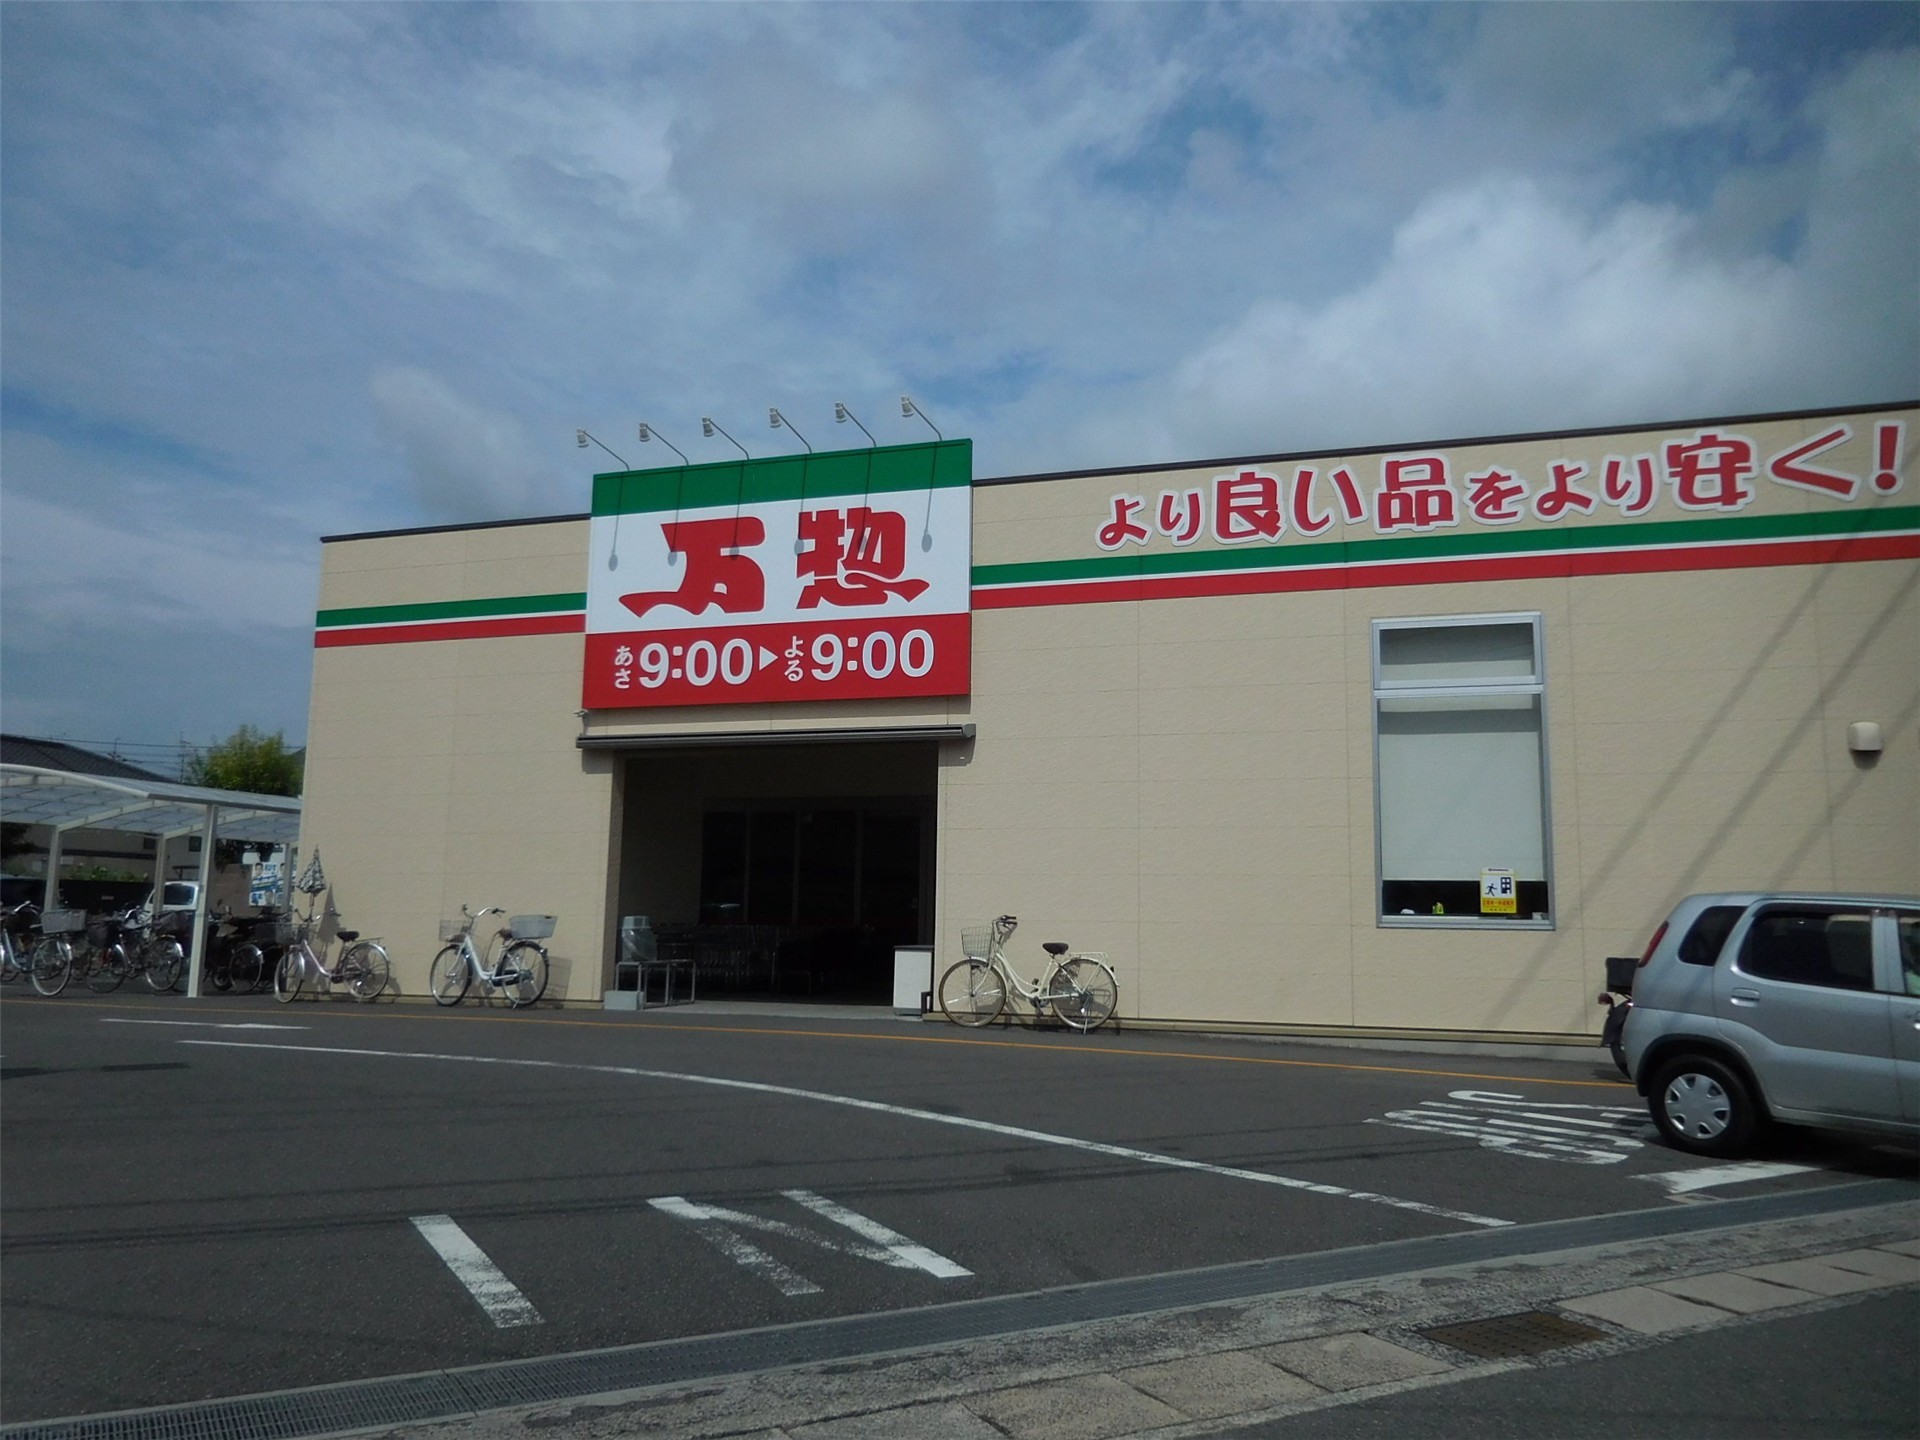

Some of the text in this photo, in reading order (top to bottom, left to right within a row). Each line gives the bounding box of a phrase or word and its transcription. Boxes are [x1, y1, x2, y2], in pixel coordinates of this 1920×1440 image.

[618, 507, 930, 618] 万惣
[614, 629, 934, 689] あさ 9:00 よる 9:00
